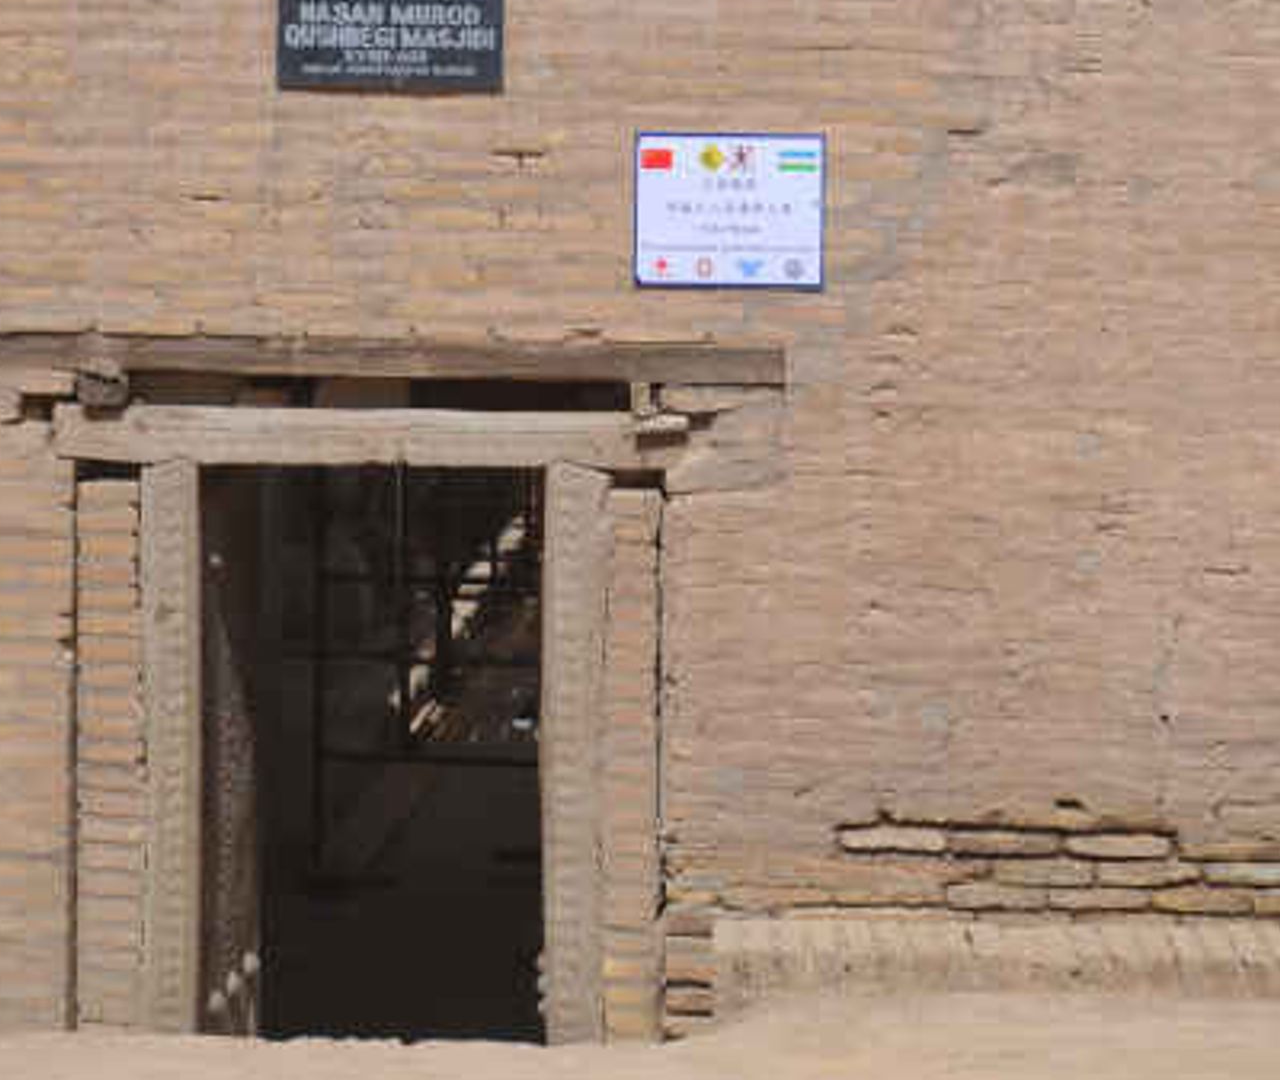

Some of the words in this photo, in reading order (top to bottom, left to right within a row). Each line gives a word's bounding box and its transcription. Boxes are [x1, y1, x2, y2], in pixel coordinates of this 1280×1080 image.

[300, 0, 384, 24] HASAN
[390, 1, 480, 25] MUROD
[400, 26, 495, 49] MASJIDI
